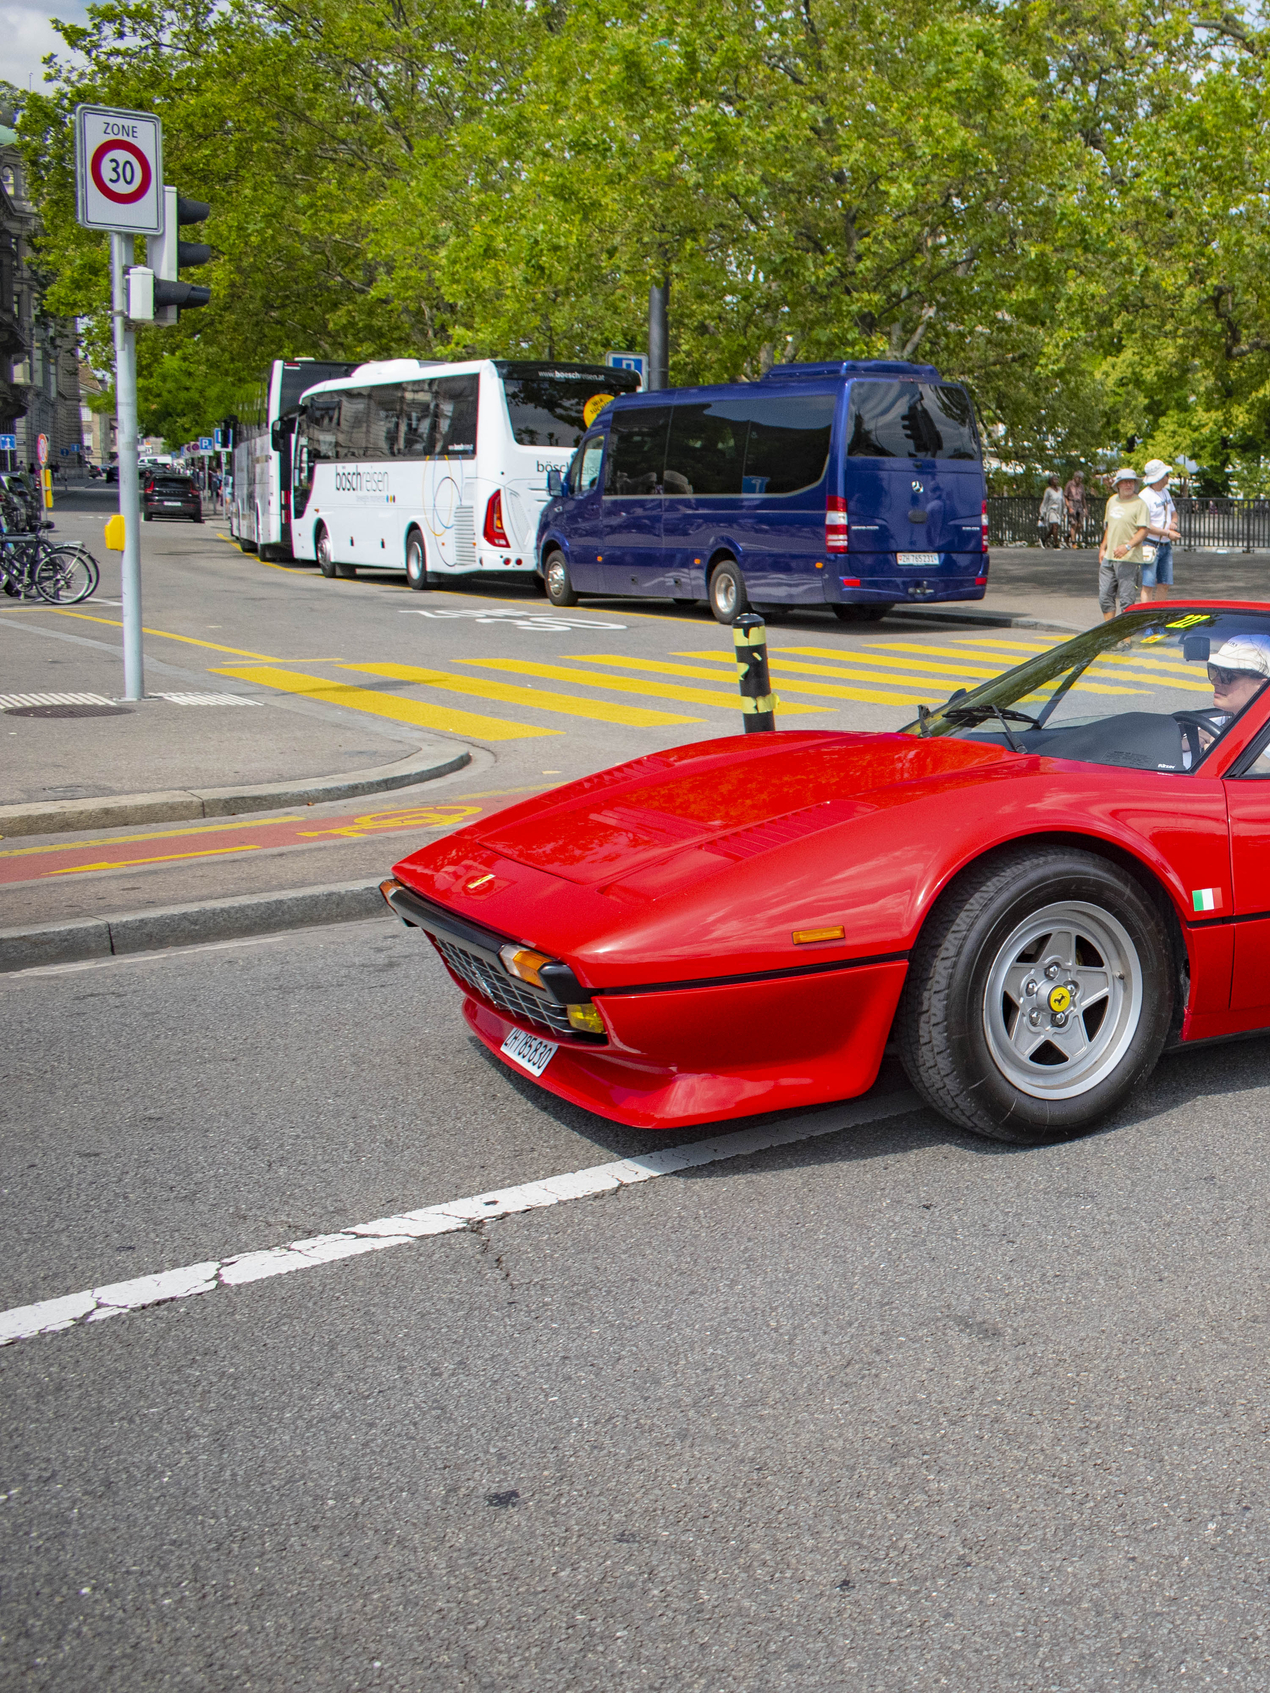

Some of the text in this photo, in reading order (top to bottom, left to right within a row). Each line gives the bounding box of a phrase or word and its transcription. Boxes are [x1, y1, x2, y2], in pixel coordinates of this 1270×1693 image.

[103, 121, 138, 139] ZONE
[108, 158, 135, 186] 30
[475, 617, 628, 632] 30
